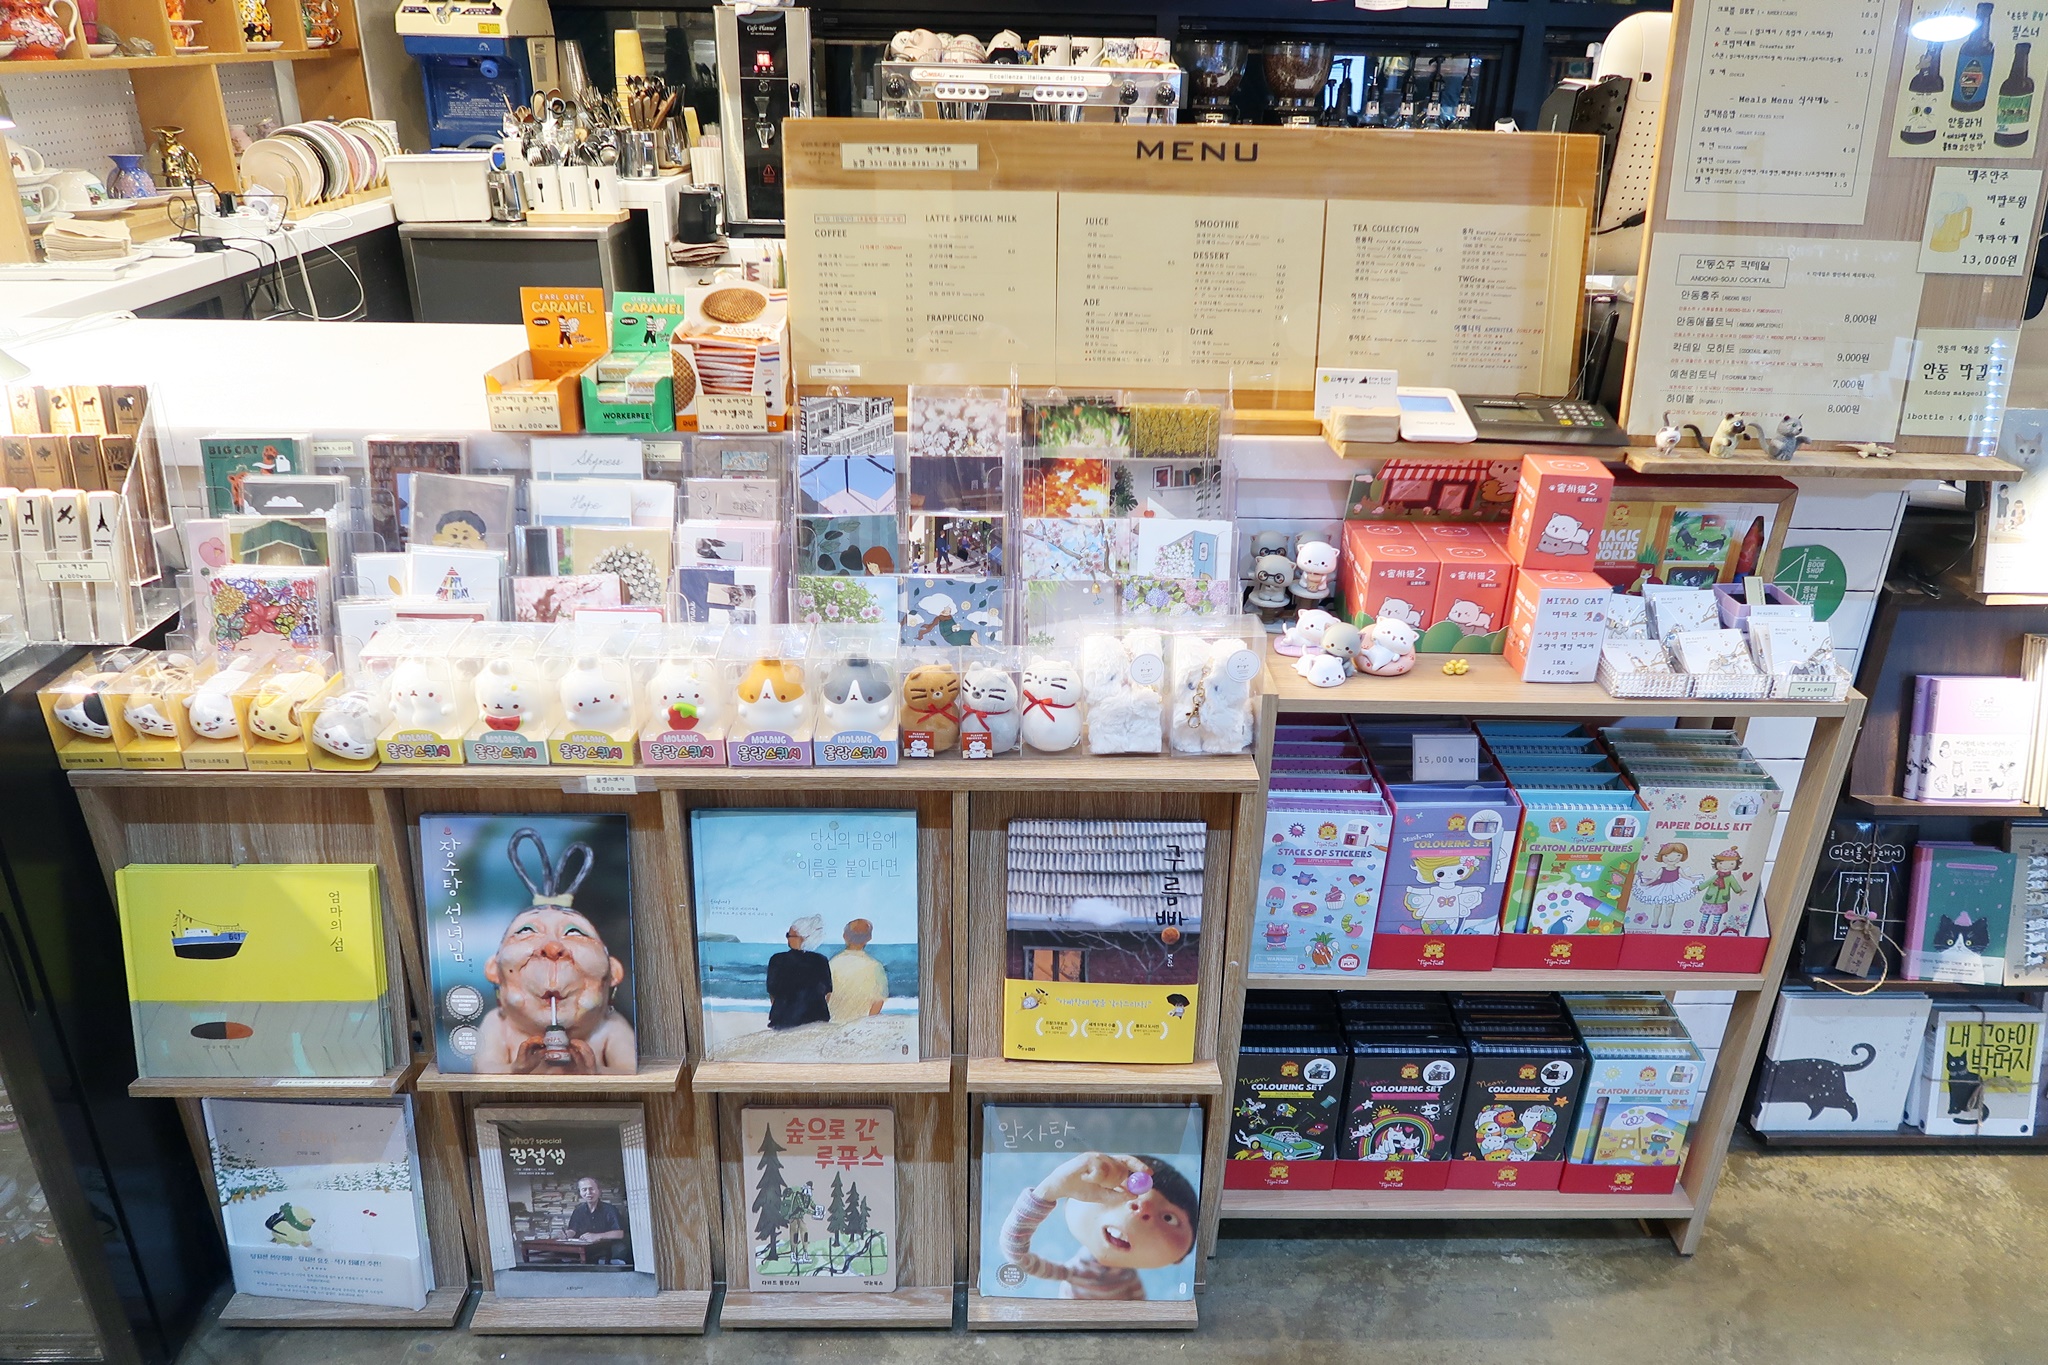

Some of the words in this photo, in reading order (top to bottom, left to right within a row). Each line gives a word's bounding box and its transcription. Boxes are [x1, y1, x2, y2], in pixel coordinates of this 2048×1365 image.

[2011, 25, 2040, 40] 필스너
[1136, 140, 1259, 162] MENU
[925, 215, 950, 223] LATTE
[959, 215, 993, 223] SPECIAL
[997, 215, 1018, 223] MILK
[1085, 217, 1109, 226] JUICE
[1194, 219, 1240, 229] SMOOTHIE
[1999, 218, 2006, 226] &
[814, 229, 848, 238] COFFEE
[1352, 224, 1368, 233] TEA
[1371, 225, 1420, 234] COLLECTION
[1193, 251, 1230, 260] DESSERT
[1962, 254, 2018, 267] 13,000원
[1696, 259, 1736, 271] 안동소주
[1690, 275, 1738, 283] ANDONG-SOJU
[1739, 276, 1772, 284] COCKTAIL
[531, 301, 596, 314] CARAMEL
[1083, 298, 1101, 307] ADE
[621, 302, 684, 315] CARAMEL
[926, 314, 985, 323] FRAPPUCCINO
[1676, 316, 1734, 327] 안동애플토닉
[1844, 313, 1878, 325] 8,000원
[1189, 327, 1214, 336] Drink
[1672, 342, 1701, 353] 칵테일
[1706, 343, 1736, 354] 모히토
[1837, 353, 1870, 364] 9,000원
[1669, 369, 1718, 380] 예천럼토닉
[1923, 363, 1949, 380] 안동
[1832, 379, 1865, 390] 7,000원
[1924, 389, 1951, 397] Andong
[1666, 393, 1695, 404] 하이볼
[1827, 404, 1860, 414] 8,000원
[1906, 412, 1944, 420] 1bottle
[725, 423, 750, 431] 2,000
[208, 445, 233, 455] BIG
[234, 445, 259, 455] CAT
[1805, 567, 1824, 575] SHOP
[435, 587, 470, 601] BIRTHDAY
[1802, 585, 1819, 594] 동네
[1546, 597, 1579, 605] MITAO
[1584, 597, 1604, 605] CAT
[1801, 592, 1817, 601] 서점
[397, 733, 434, 743] MOLANG
[485, 734, 521, 743] MOLANG
[572, 734, 607, 743] MOLANG
[663, 734, 699, 744] MOLANG
[751, 734, 787, 745] MOLANG
[837, 734, 873, 744] MOLANG
[1418, 755, 1454, 765] 15,000
[1458, 756, 1476, 764] won
[1655, 820, 1690, 831] PAPER
[1694, 821, 1729, 832] DOLLS
[1732, 822, 1752, 832] KIT
[810, 828, 850, 851] 당신의
[857, 830, 898, 850] 마음에
[1402, 832, 1435, 843] Mash-up
[1413, 839, 1471, 849] COLOURING
[1472, 839, 1491, 847] SET
[1569, 844, 1633, 853] ADVENTURES
[1277, 848, 1312, 857] STACKS
[1315, 849, 1328, 857] OF
[1330, 849, 1372, 858] STICKERS
[439, 837, 463, 898] 장수탕
[798, 858, 838, 878] 이름을
[845, 858, 901, 878] 붙인다면
[1155, 844, 1189, 927] 구름빵
[328, 890, 343, 932] 엄마의
[444, 902, 465, 963] 선녀님
[330, 936, 344, 953] 섬
[1949, 1024, 1970, 1048] 내
[1976, 1023, 2035, 1052] 고양이
[1251, 1083, 1304, 1091] COLOURING
[1306, 1083, 1324, 1091] SET
[1371, 1085, 1424, 1093] COLOURING
[1425, 1085, 1443, 1093] SET
[1487, 1086, 1541, 1094] COLOURING
[1542, 1086, 1560, 1094] SET
[1632, 1088, 1690, 1096] ADVENTURES
[785, 1117, 846, 1145] 숲으로
[854, 1117, 880, 1142] 간
[998, 1119, 1076, 1149] 알사탕
[509, 1137, 535, 1146] who?
[509, 1147, 566, 1166] 권정생
[815, 1145, 885, 1172] 루푸스
